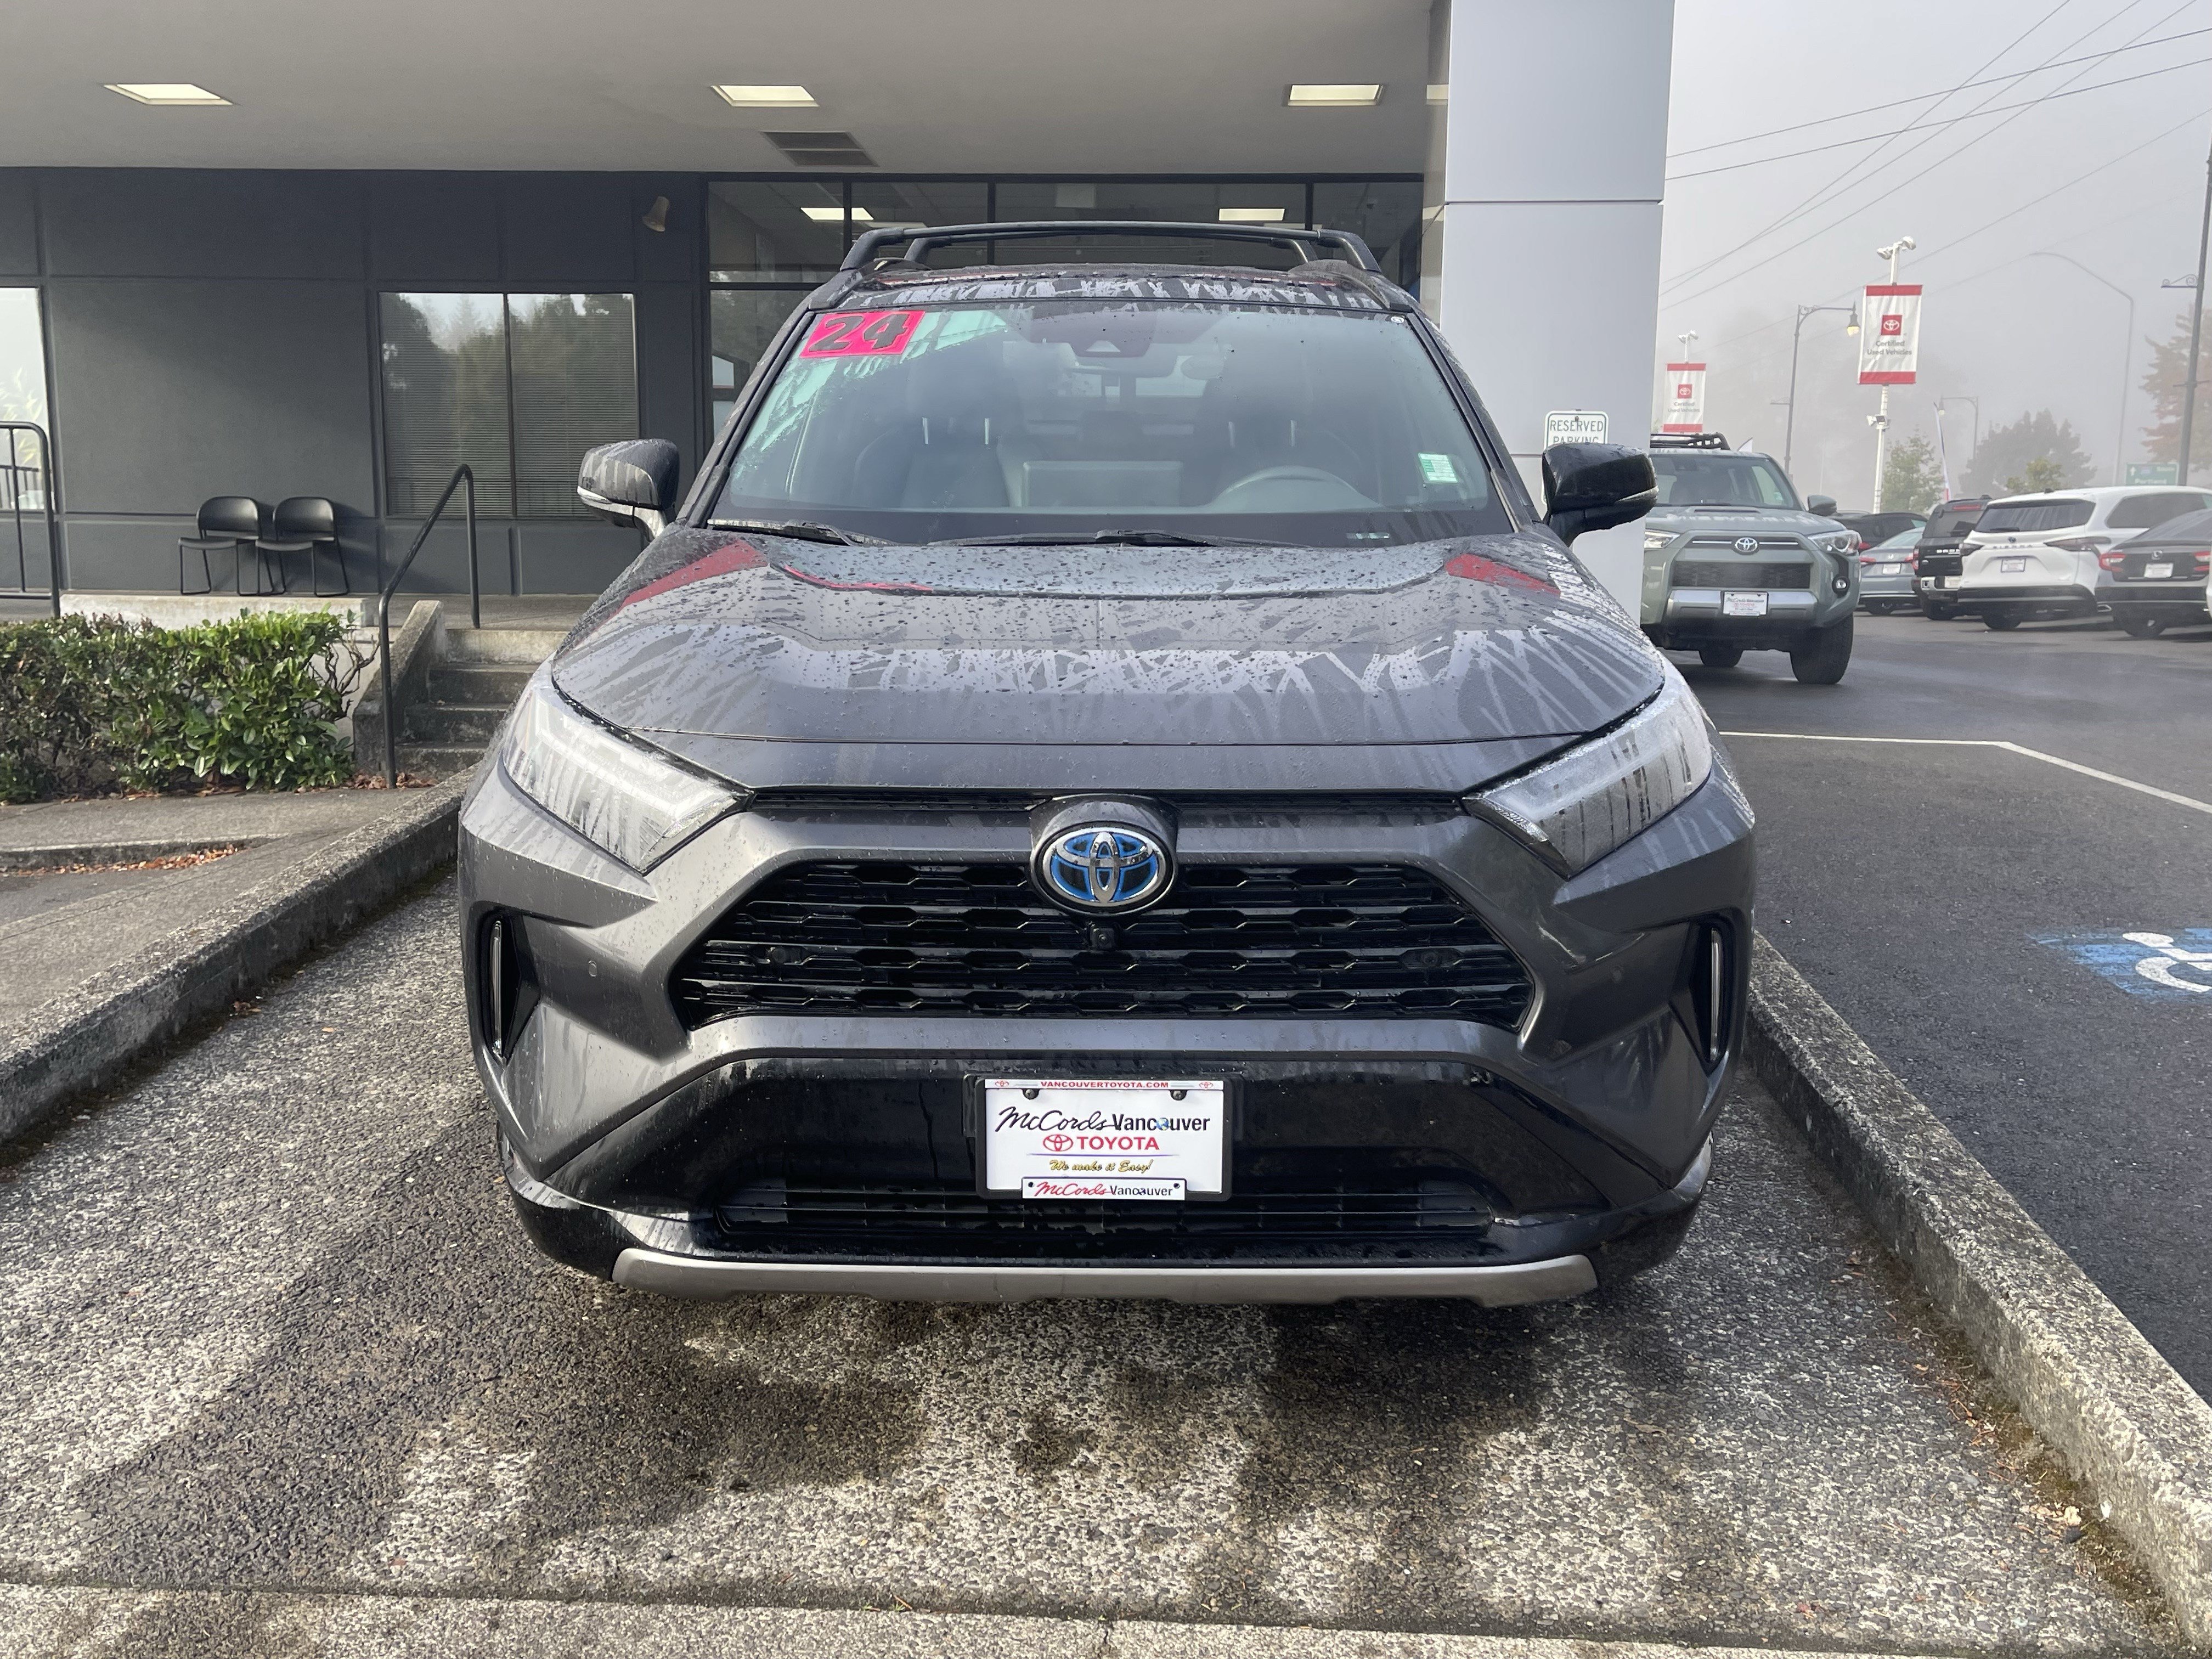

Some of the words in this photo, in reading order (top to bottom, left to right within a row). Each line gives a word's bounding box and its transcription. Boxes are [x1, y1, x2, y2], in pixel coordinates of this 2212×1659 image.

[809, 313, 910, 352] 24
[1550, 420, 1604, 432] RESERVED
[1076, 1136, 1160, 1151] TOYOTA
[1049, 1160, 1069, 1171] We
[1071, 1161, 1103, 1171] make
[1105, 1161, 1115, 1172] it
[1118, 1159, 1154, 1174] Easy!
